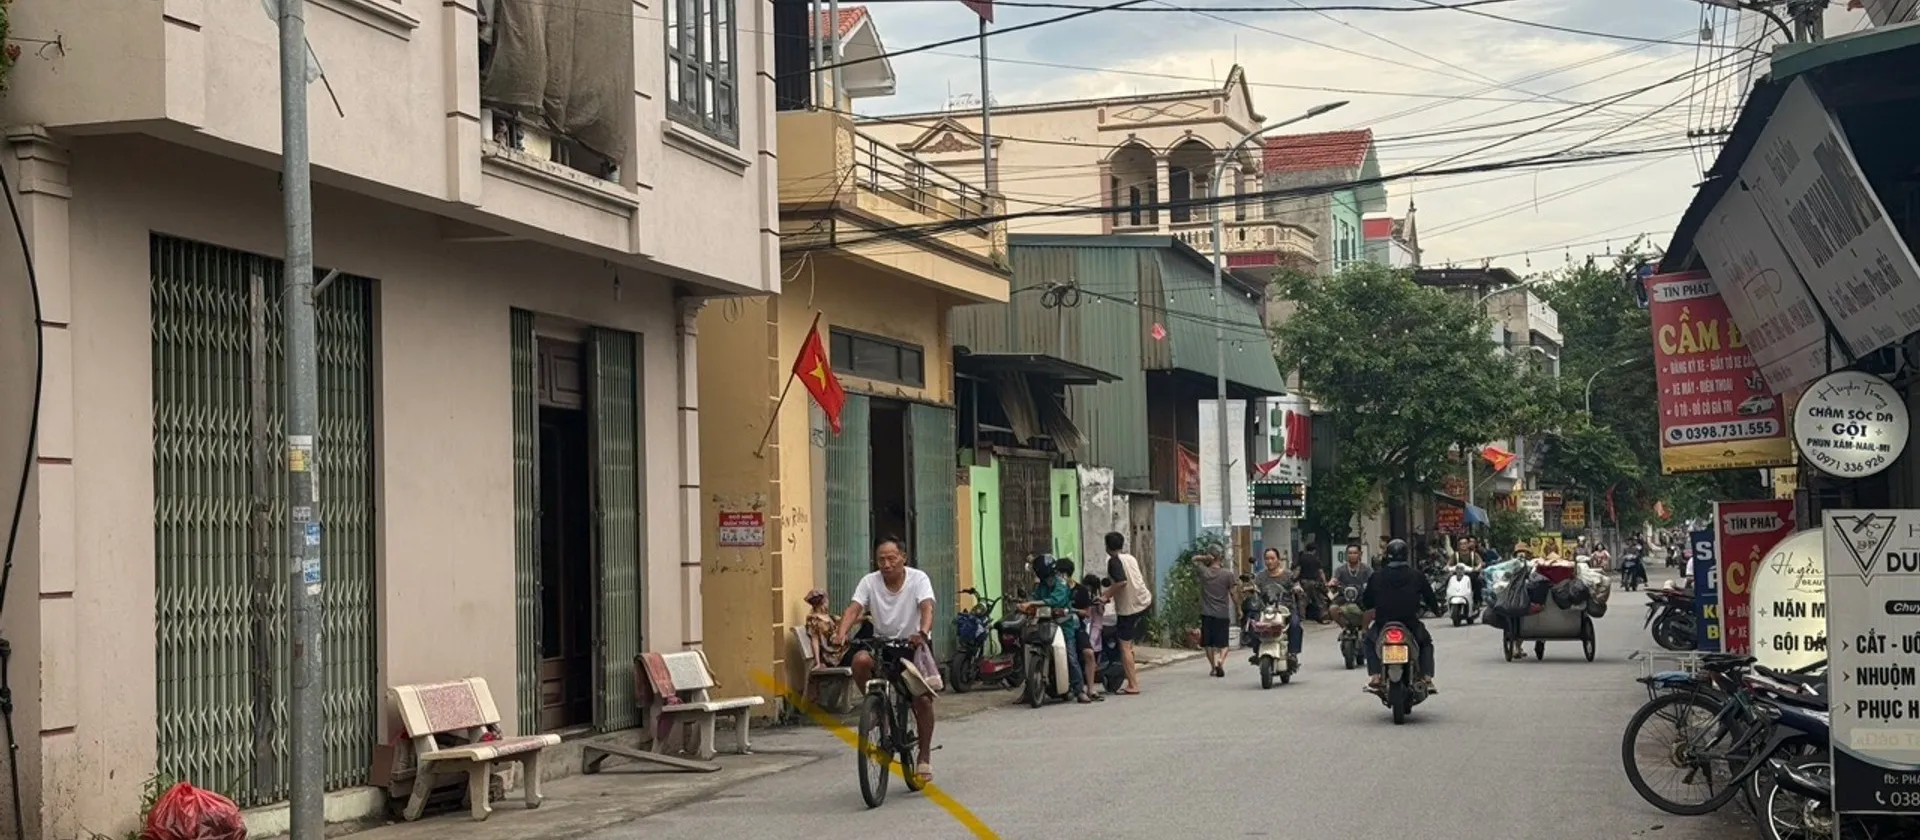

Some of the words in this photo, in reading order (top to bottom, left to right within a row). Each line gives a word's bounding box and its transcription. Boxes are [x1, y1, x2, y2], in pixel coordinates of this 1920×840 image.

[1658, 305, 1721, 355] CẦM
[1847, 407, 1873, 421] SÓC
[1876, 412, 1893, 423] DA
[1686, 421, 1772, 440] 0398.731.555
[1831, 421, 1867, 440] GỘI
[1806, 438, 1831, 448] PHUN
[1816, 451, 1841, 470] 0971
[1843, 462, 1863, 472] 336
[1864, 454, 1885, 469] 926
[1730, 516, 1747, 530] TÍN
[1750, 515, 1777, 529] PHÁT
[1887, 552, 1920, 573] DU
[1773, 598, 1806, 621] NẶN
[1773, 631, 1799, 654] GỘI
[1856, 627, 1887, 654] CẮT
[1857, 662, 1916, 690] NHUỘM
[1858, 700, 1903, 723] PHỤC
